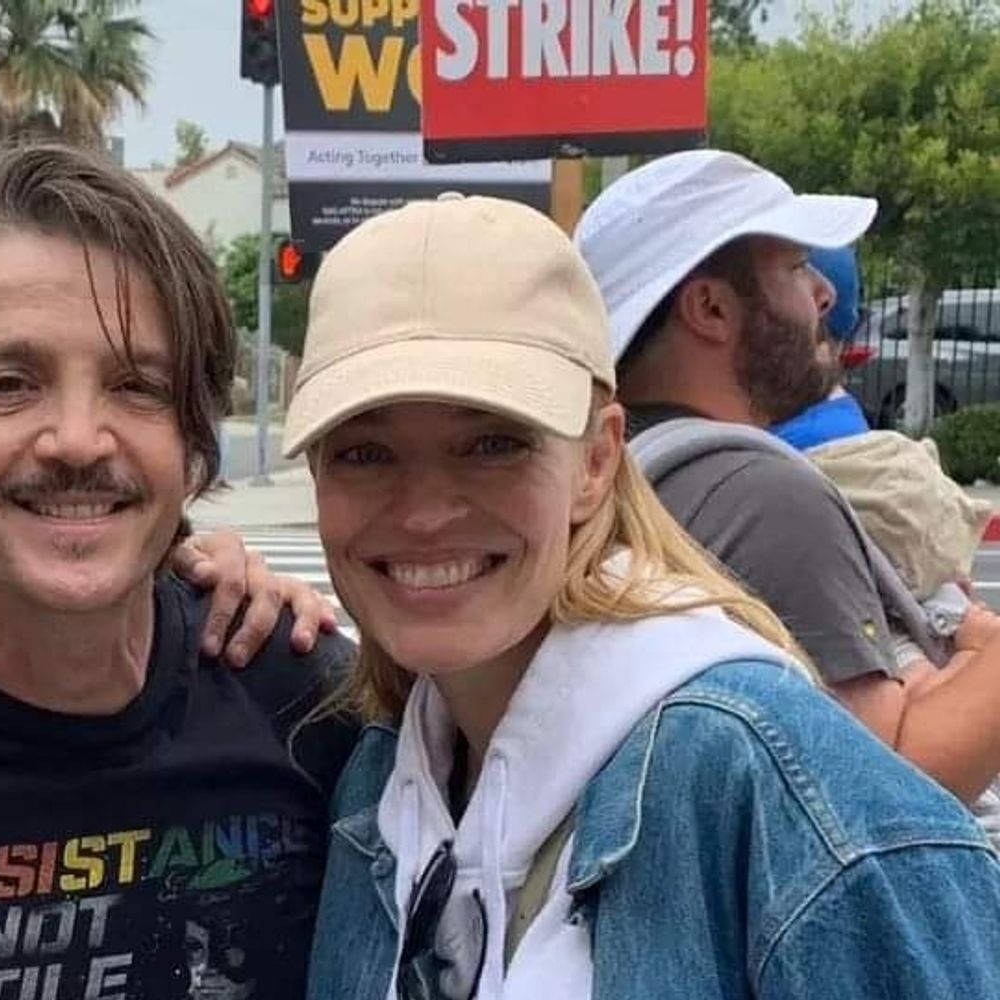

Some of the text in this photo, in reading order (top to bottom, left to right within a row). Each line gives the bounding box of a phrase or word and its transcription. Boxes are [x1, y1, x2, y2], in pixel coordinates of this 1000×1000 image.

[302, 34, 421, 111] W
[435, 0, 695, 80] STRIKE!
[307, 150, 419, 167] Acting Together
